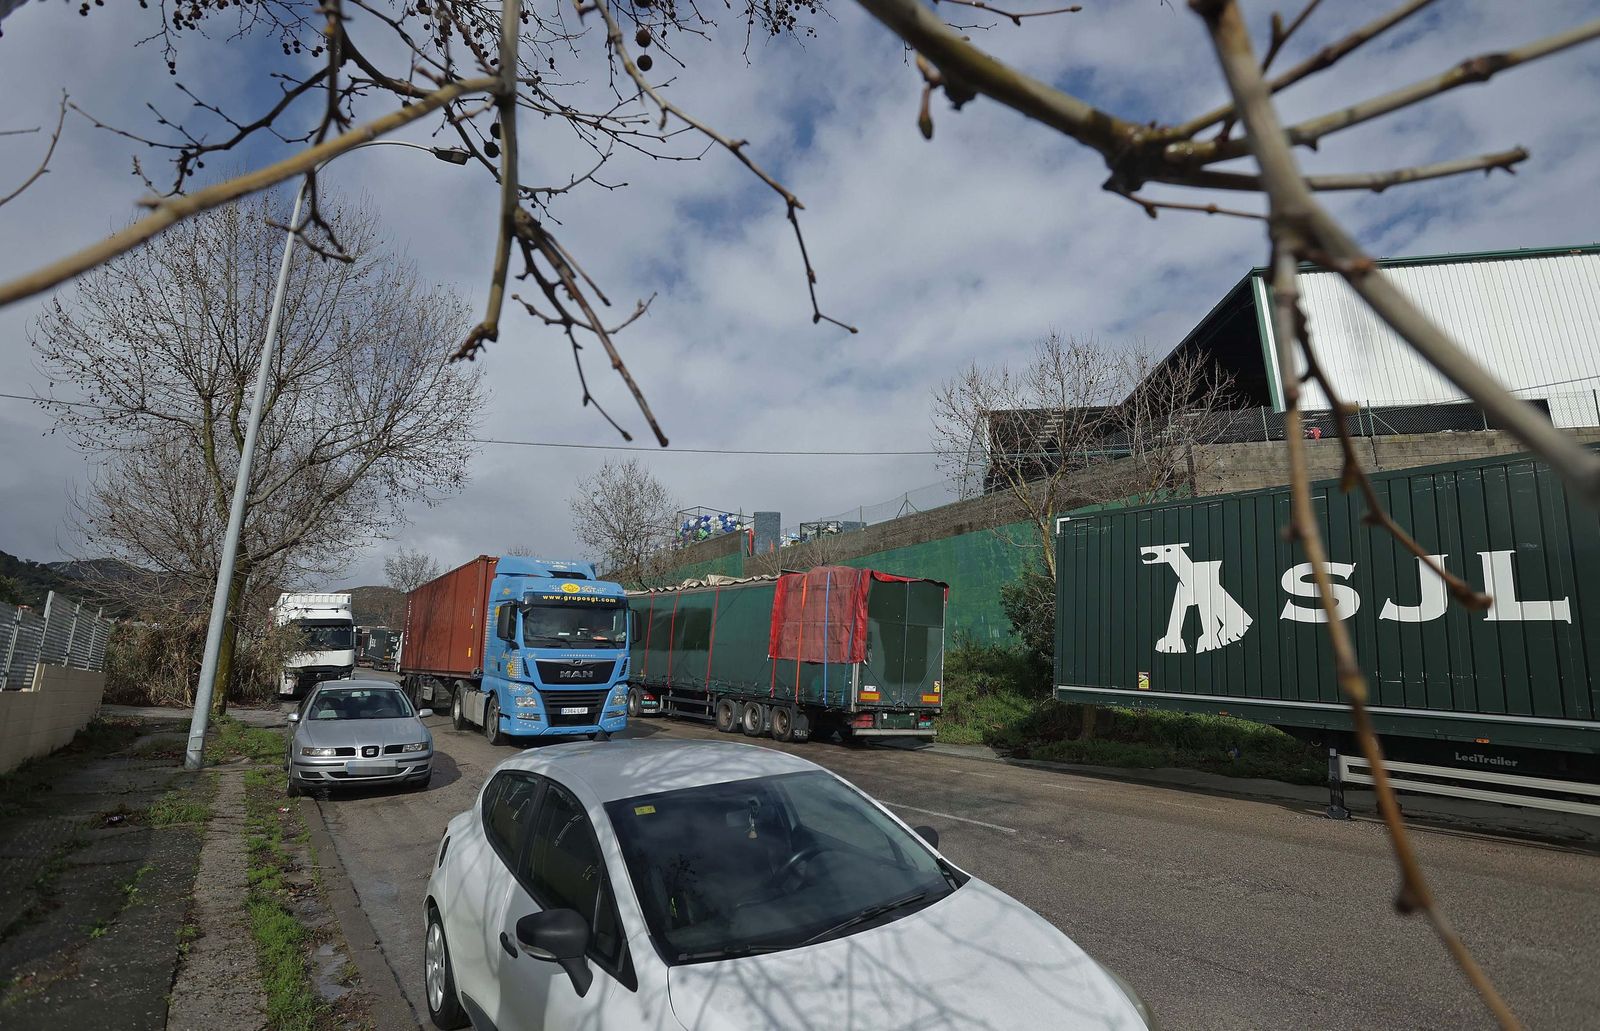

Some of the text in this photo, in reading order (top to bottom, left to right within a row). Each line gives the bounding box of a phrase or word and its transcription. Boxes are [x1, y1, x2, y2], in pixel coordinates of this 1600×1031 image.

[1279, 549, 1572, 624] SJL
[542, 594, 616, 604] www.gruposgt.com
[560, 670, 593, 678] MAN
[794, 729, 808, 737] SJL
[1455, 752, 1519, 767] LeciTrailer
